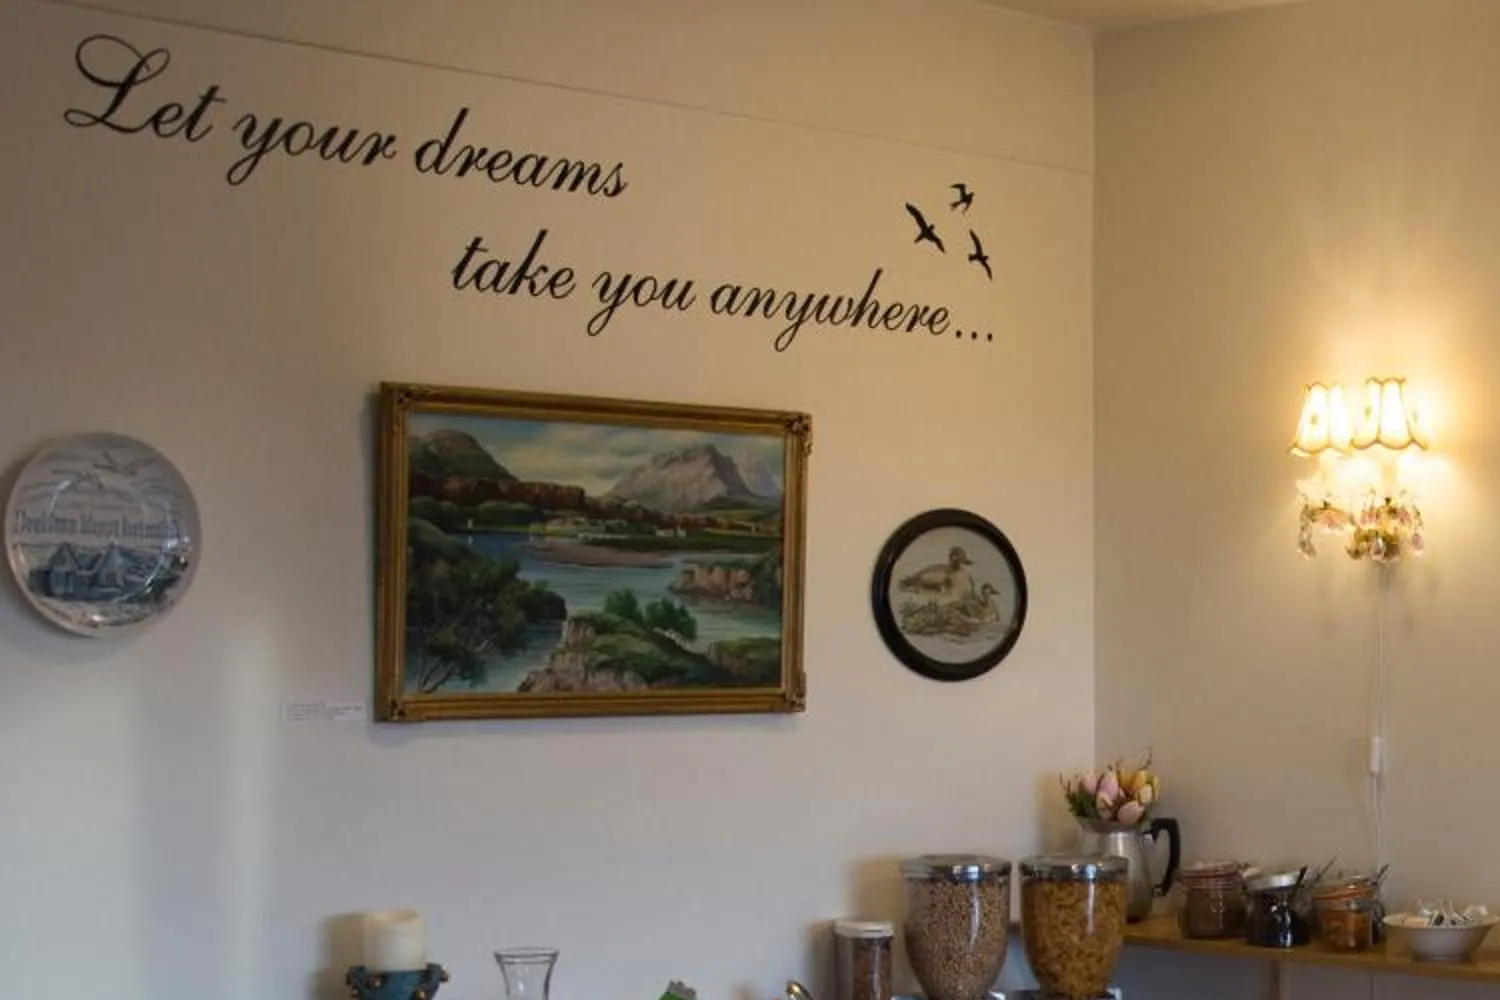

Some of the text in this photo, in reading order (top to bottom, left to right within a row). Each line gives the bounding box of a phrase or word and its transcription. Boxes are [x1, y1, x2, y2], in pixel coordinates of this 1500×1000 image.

[63, 34, 629, 199] Let your dreams
[450, 228, 995, 353] take you anywhere...
